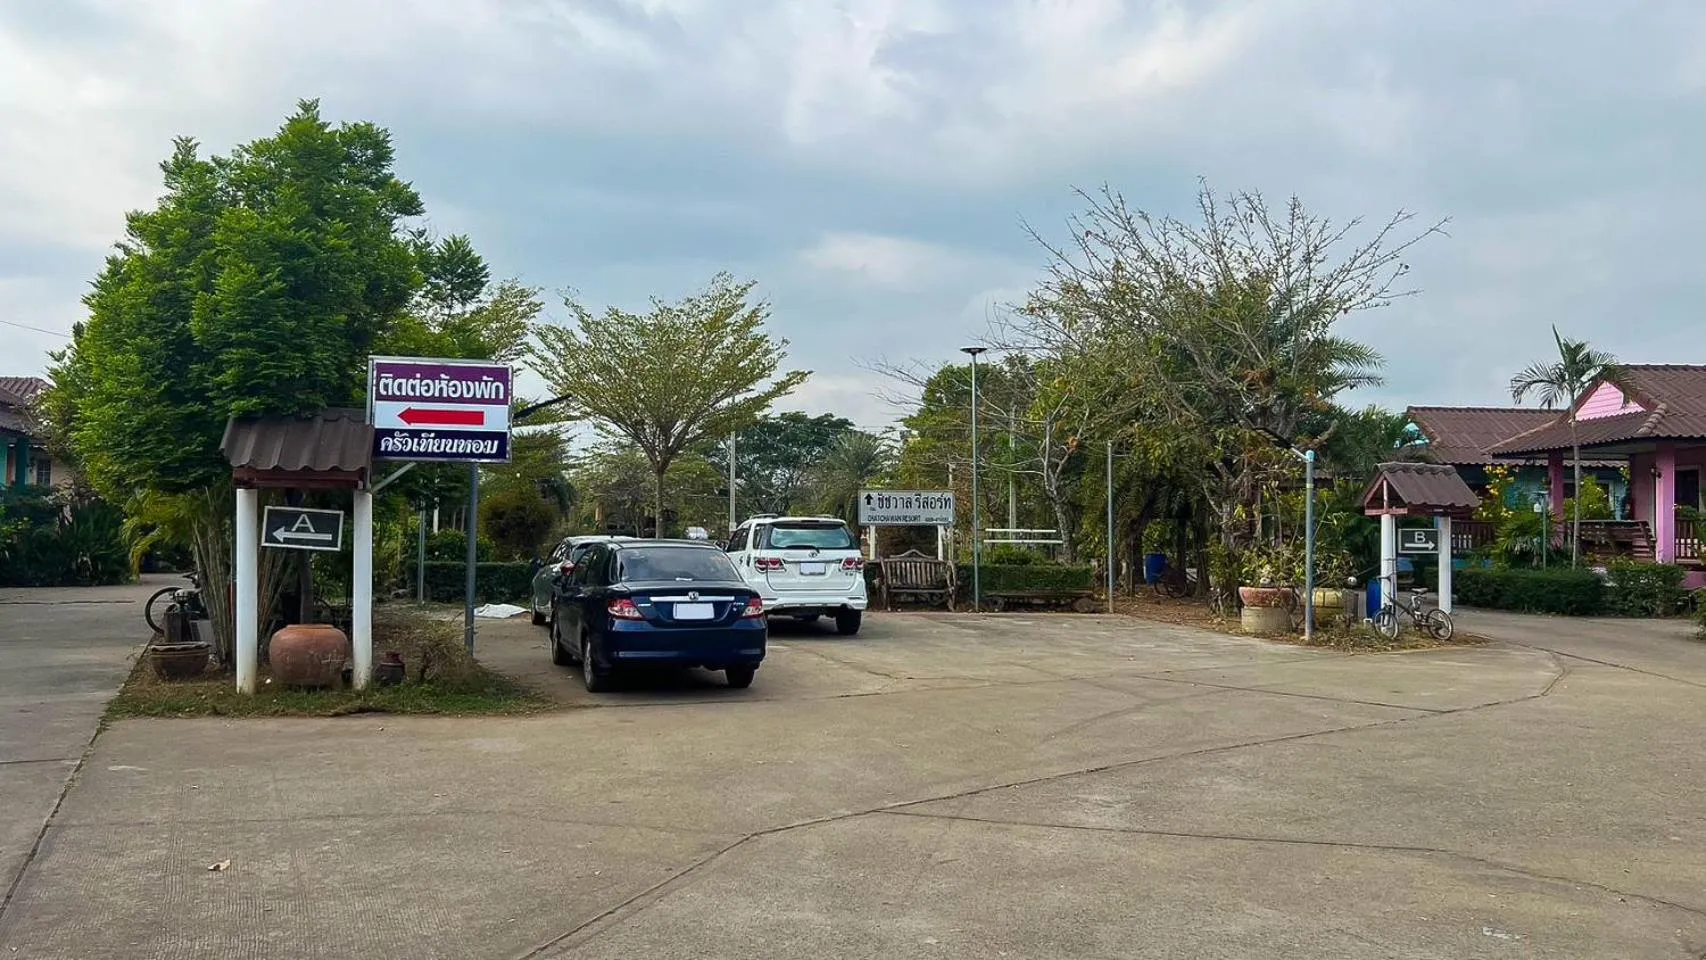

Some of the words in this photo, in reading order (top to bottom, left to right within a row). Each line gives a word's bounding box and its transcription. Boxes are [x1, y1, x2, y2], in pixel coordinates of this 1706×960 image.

[379, 373, 504, 399] ติดต่อห้องพัก
[380, 431, 499, 454] ครัวเทียนหอม
[291, 513, 315, 533] A
[902, 514, 921, 522] RESORT
[1414, 531, 1426, 543] B
